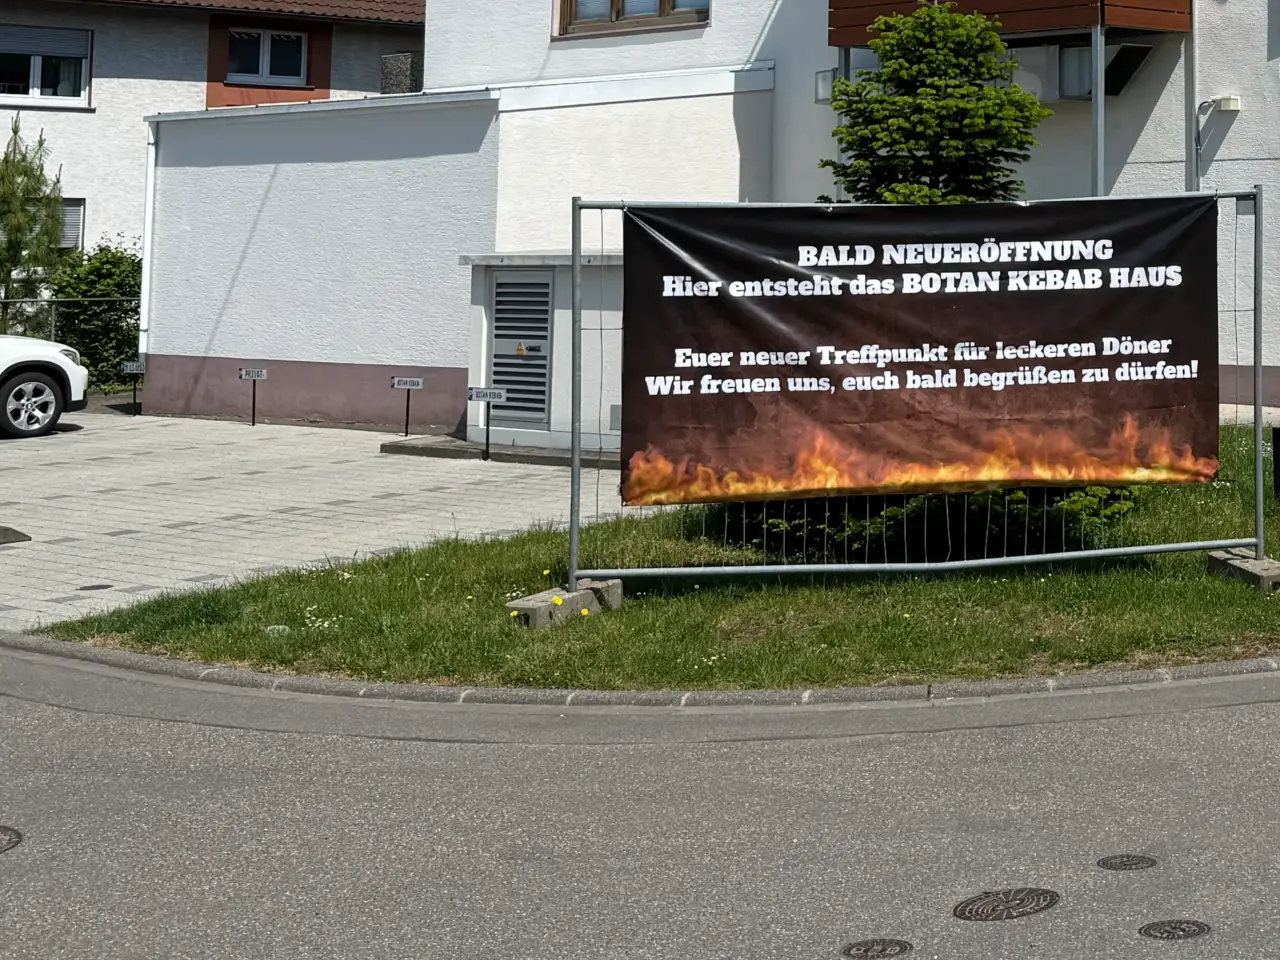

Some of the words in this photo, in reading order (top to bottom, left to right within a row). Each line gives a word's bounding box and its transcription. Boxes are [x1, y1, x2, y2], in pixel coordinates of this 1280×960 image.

[798, 245, 875, 266] BALD
[882, 238, 1114, 265] NEUERÖFFNUNG
[662, 275, 722, 297] Hier
[728, 275, 843, 297] entsteht
[850, 274, 895, 295] das
[901, 271, 1000, 294] BOTAN
[1007, 268, 1102, 291] KEBAB
[1109, 265, 1182, 289] HAUS
[674, 348, 734, 368] Euer
[739, 350, 810, 366] neuer
[816, 344, 948, 368] Treffpunkt
[954, 342, 989, 361] für
[995, 340, 1097, 360] leckeren
[1102, 336, 1172, 356] Döner
[645, 376, 694, 396] Wir
[700, 374, 781, 394] freuen
[787, 377, 836, 394] uns,
[842, 370, 900, 391] euch
[905, 369, 957, 389] bald
[963, 366, 1076, 391] begrüßen
[1081, 368, 1109, 383] zu
[1115, 360, 1199, 381] dürfen!
